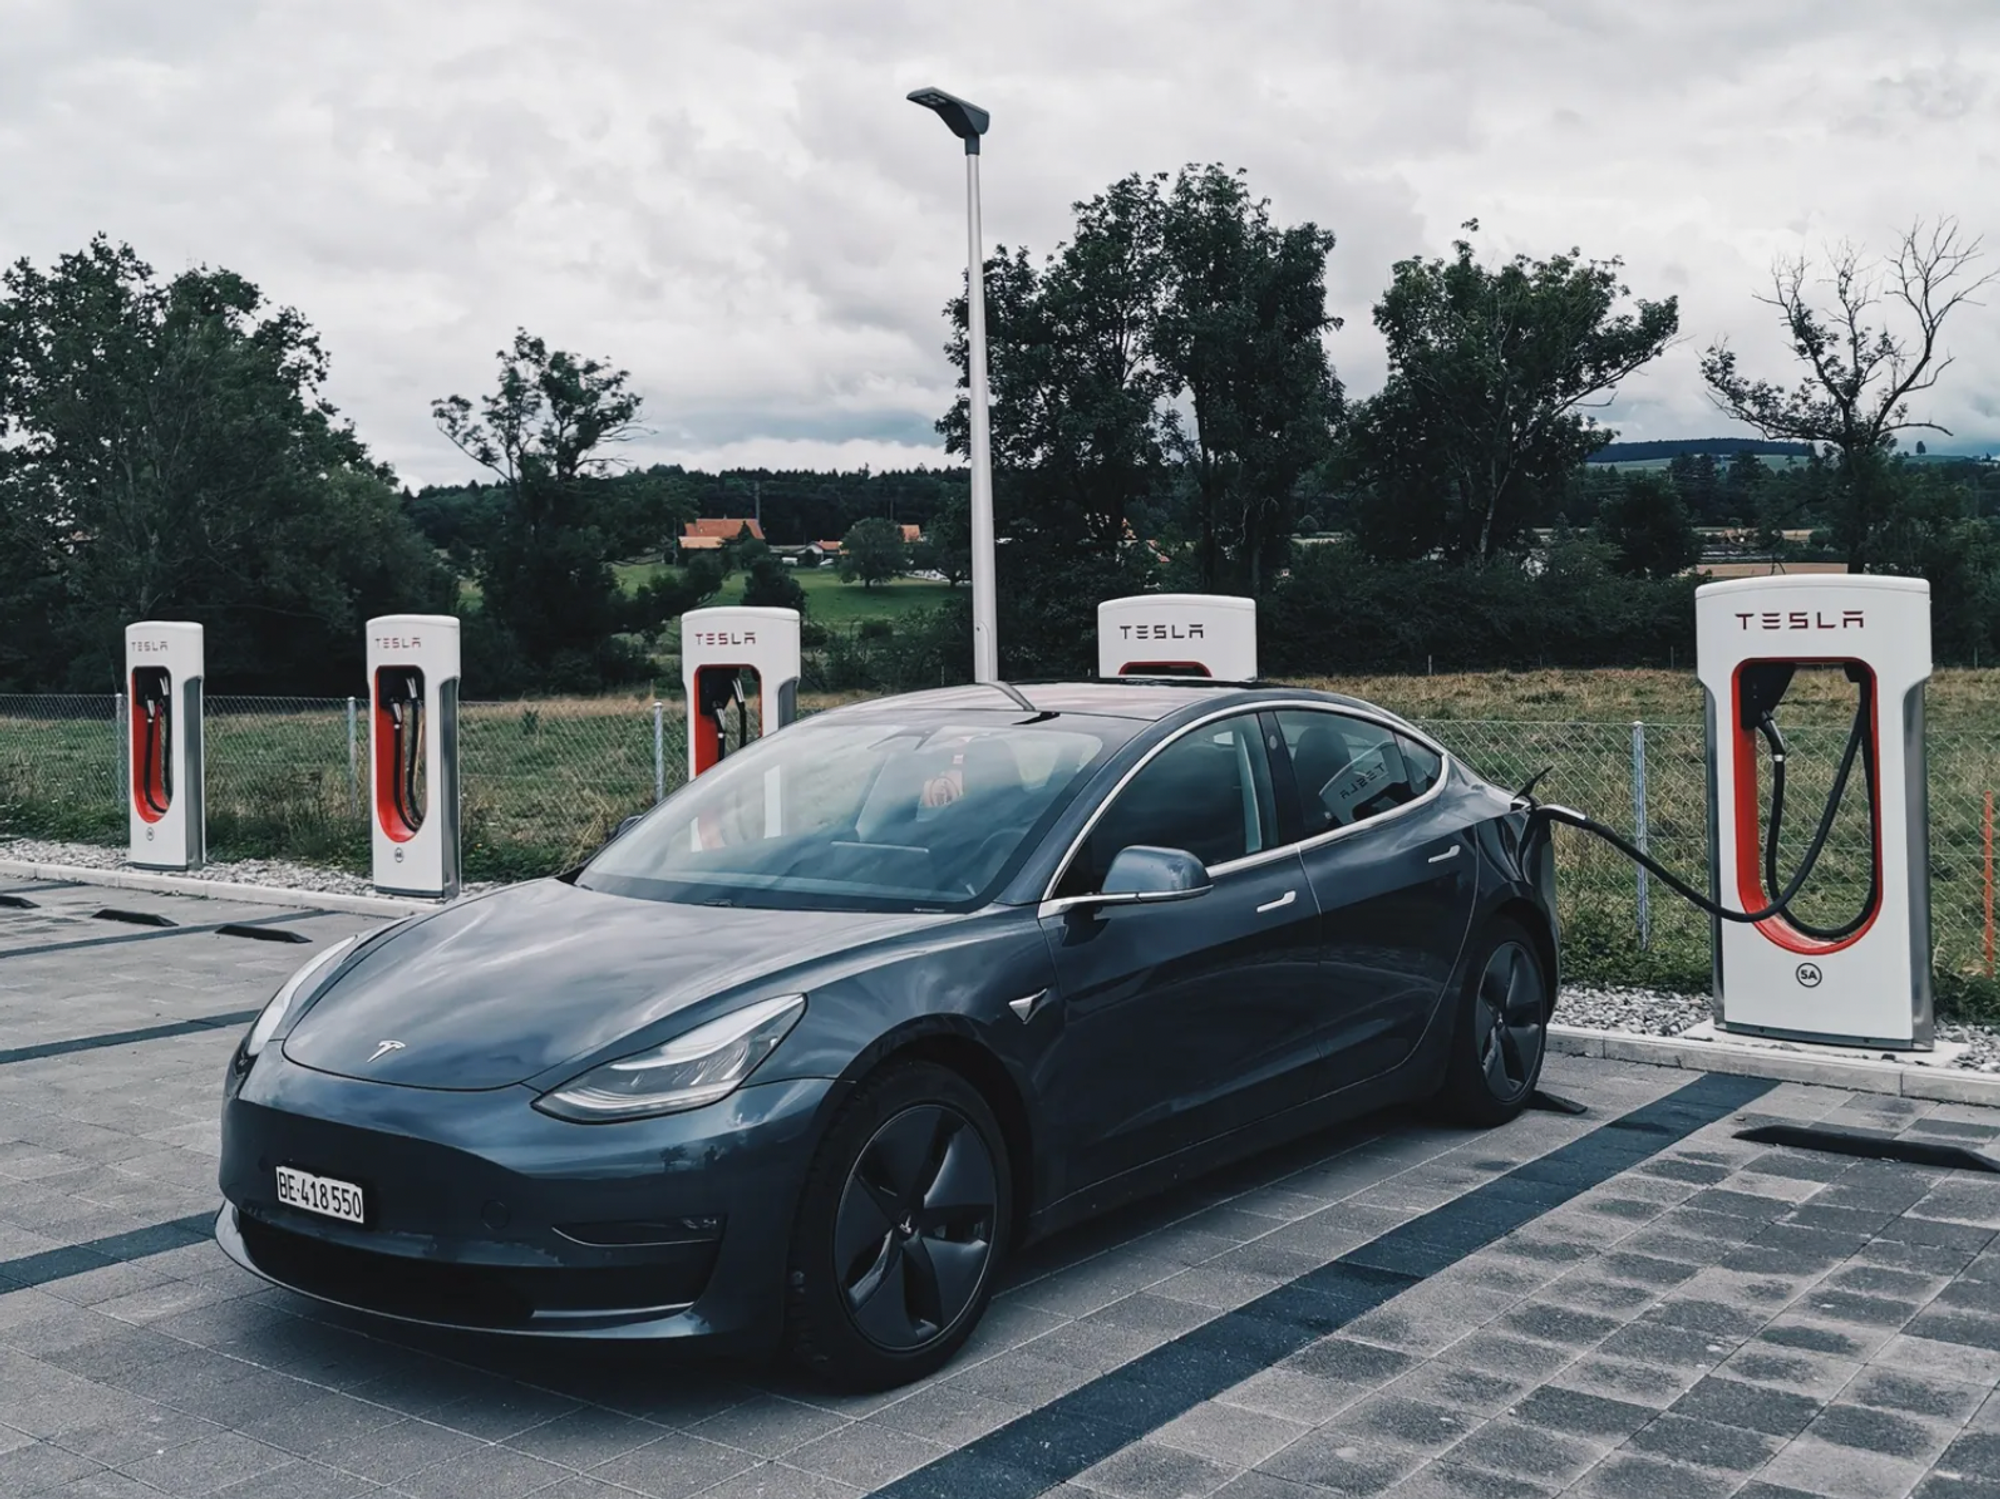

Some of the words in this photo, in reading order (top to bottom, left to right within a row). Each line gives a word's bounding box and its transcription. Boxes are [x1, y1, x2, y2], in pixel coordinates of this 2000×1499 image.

[1734, 610, 1864, 631] TESLA
[1119, 623, 1204, 640] TESLA
[375, 637, 421, 649] TESLA
[695, 632, 756, 646] TESLA
[131, 641, 168, 652] TESLA
